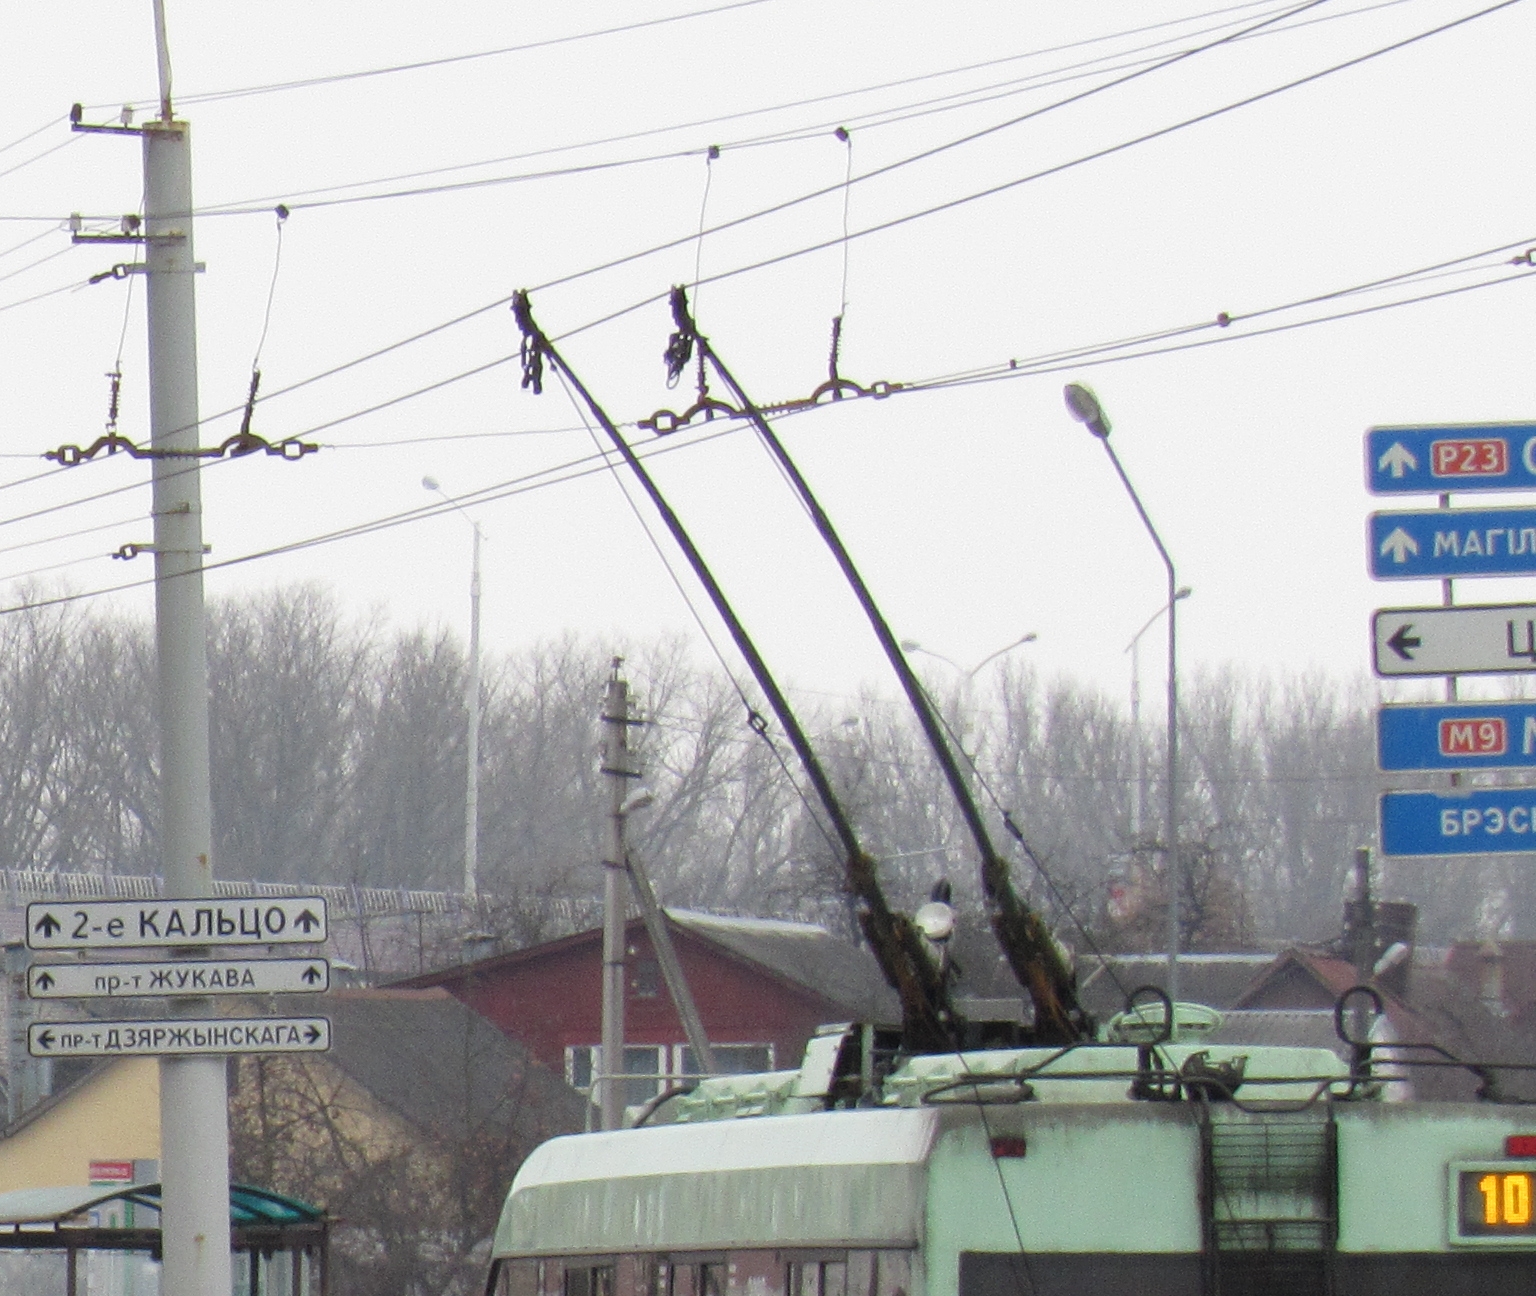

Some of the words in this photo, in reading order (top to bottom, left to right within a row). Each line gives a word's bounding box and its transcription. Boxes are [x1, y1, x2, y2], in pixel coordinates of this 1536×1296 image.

[1438, 443, 1499, 472] Р23
[1448, 722, 1497, 752] М9
[1439, 806, 1536, 837] БРЭС
[71, 910, 125, 940] 2-е
[138, 905, 288, 941] КАЛЬЦО
[94, 972, 142, 995] пр-т
[148, 967, 256, 990] ЖУКАВА
[103, 1024, 301, 1050] ДЗЯРЖЫНСКАГА
[1479, 1173, 1531, 1225] 10
